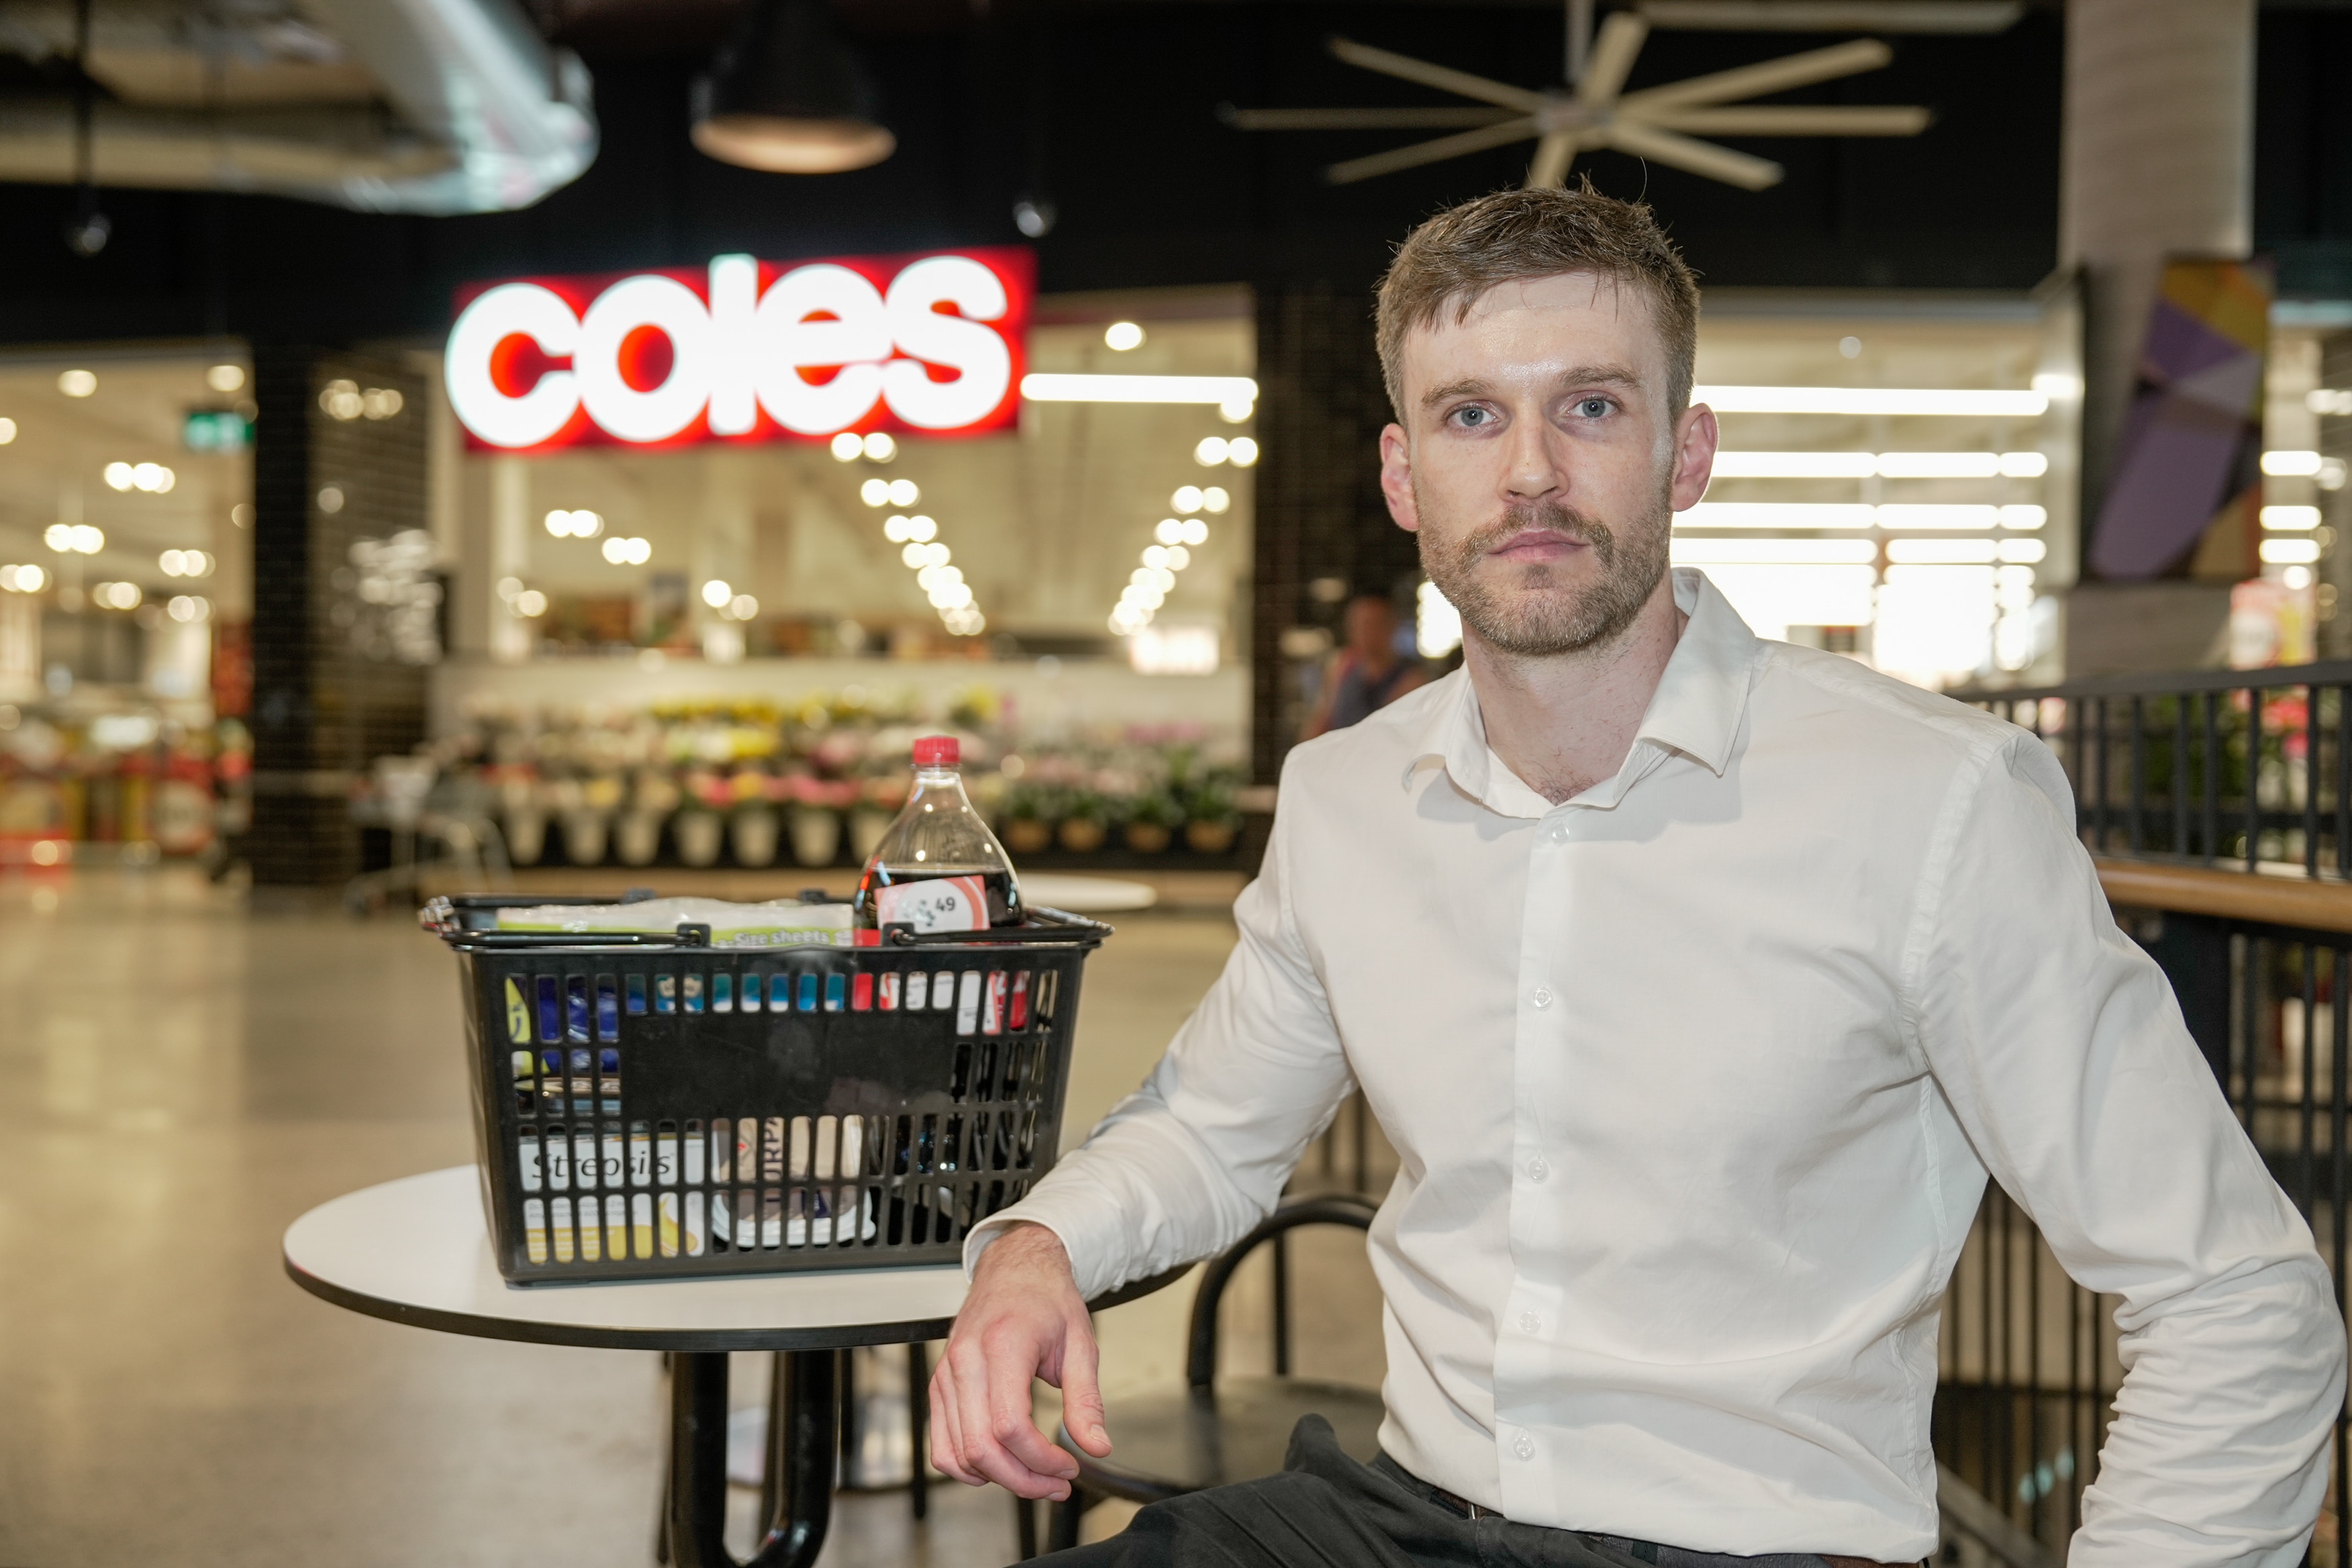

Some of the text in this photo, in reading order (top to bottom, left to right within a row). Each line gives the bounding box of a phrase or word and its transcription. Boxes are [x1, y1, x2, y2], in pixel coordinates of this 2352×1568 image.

[444, 253, 1011, 448] coles
[772, 928, 830, 944] sheets
[532, 1150, 671, 1178] Stepsis
